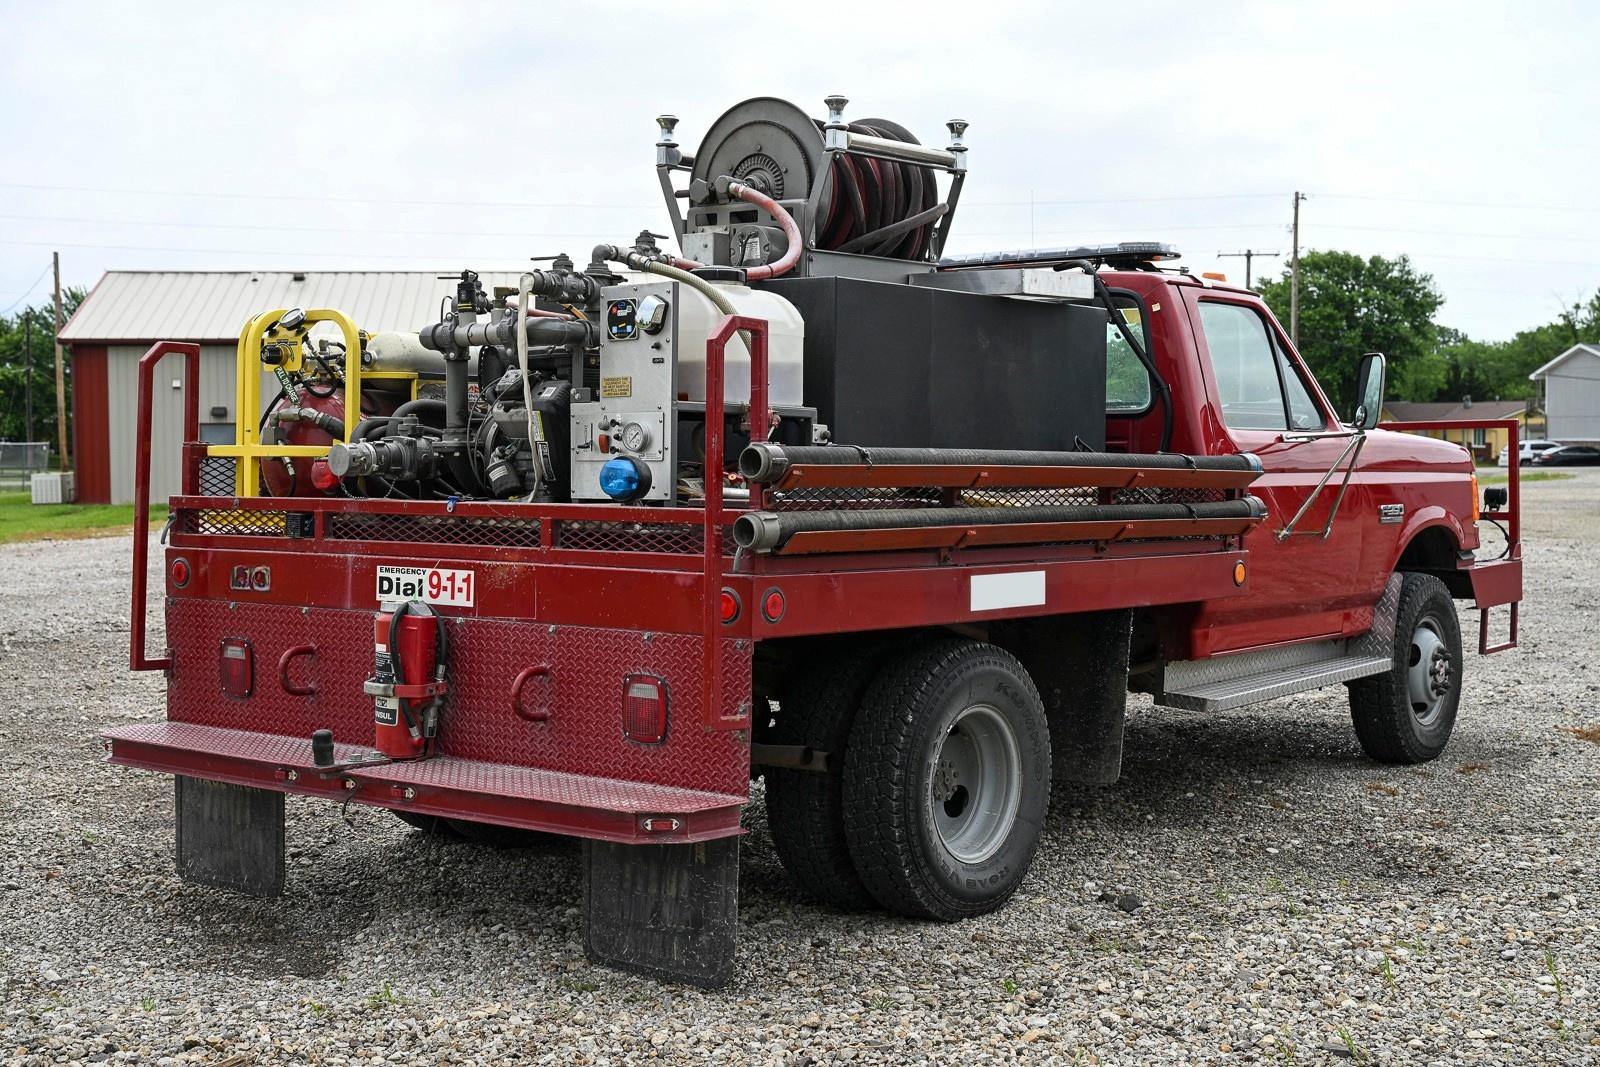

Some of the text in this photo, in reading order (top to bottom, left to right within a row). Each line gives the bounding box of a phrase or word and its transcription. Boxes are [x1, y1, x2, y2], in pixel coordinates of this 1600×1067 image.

[380, 567, 427, 576] EMERGENCY
[379, 570, 472, 602] Dial 9-1-1
[376, 711, 393, 720] NSUL
